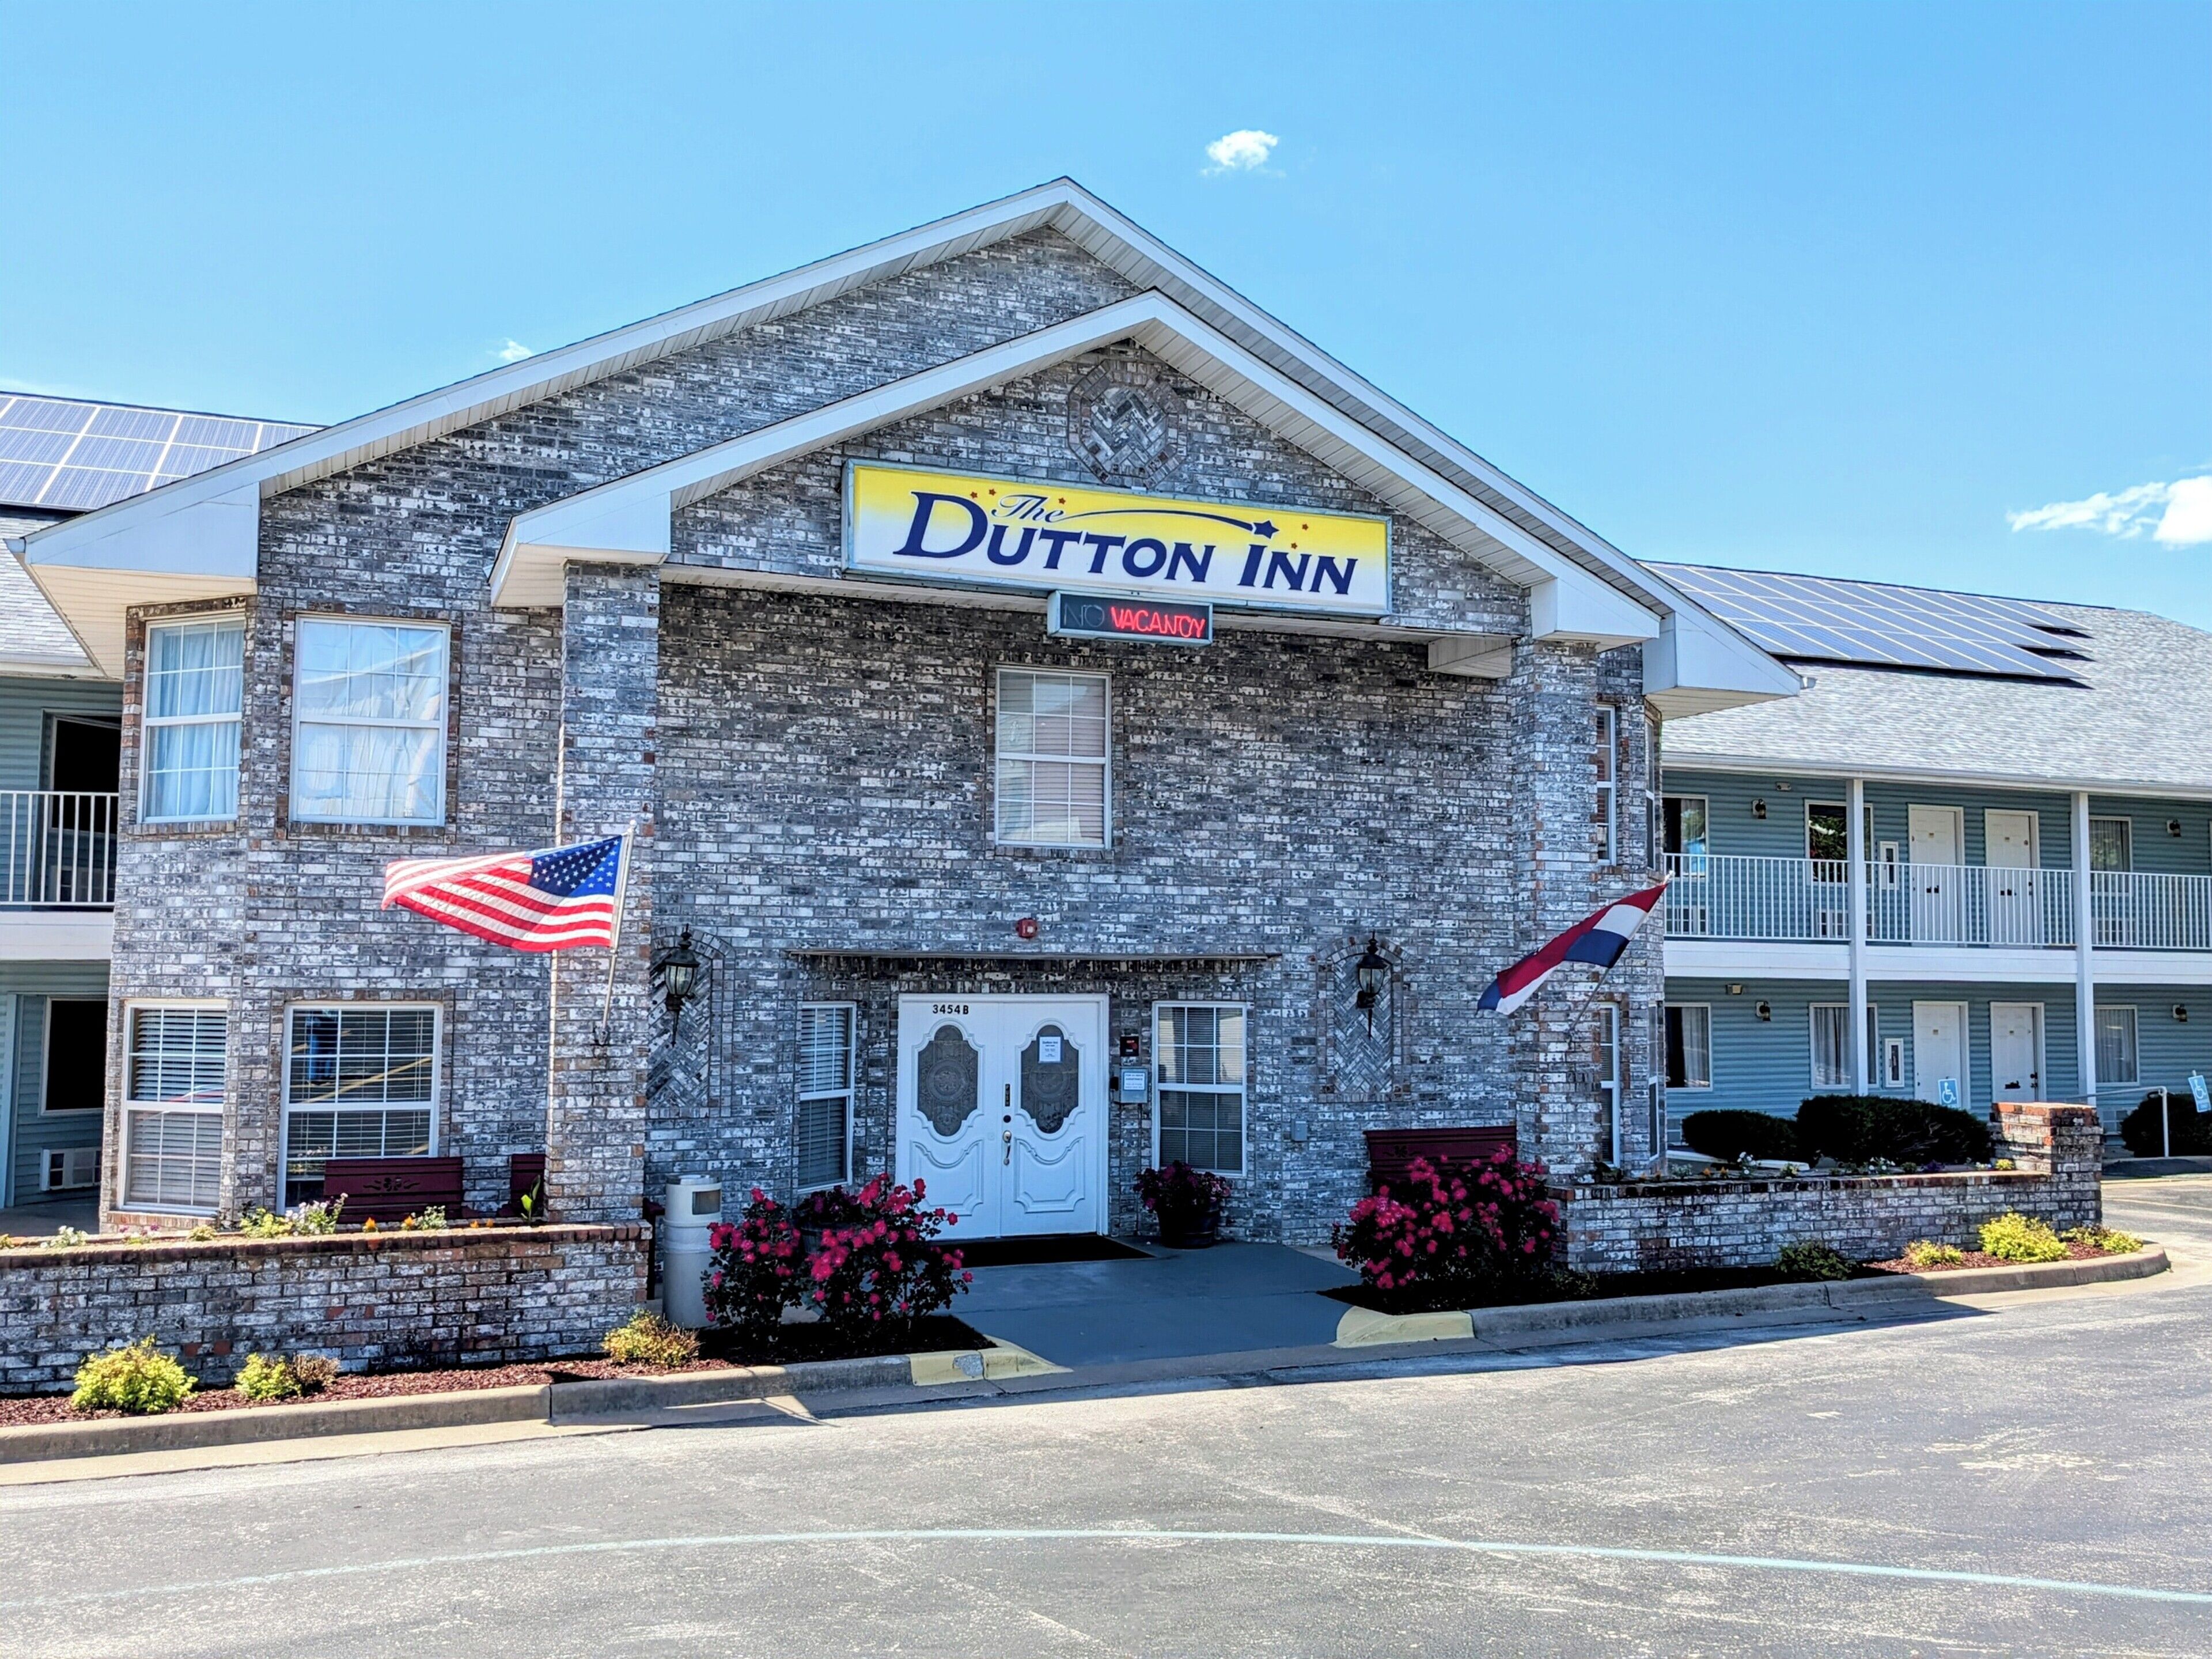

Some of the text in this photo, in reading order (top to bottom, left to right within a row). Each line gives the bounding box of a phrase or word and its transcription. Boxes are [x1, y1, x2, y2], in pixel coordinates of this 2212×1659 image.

[991, 494, 1066, 522] The
[892, 491, 1359, 595] DUTTON INN
[1063, 604, 1206, 638] NO VACANCY
